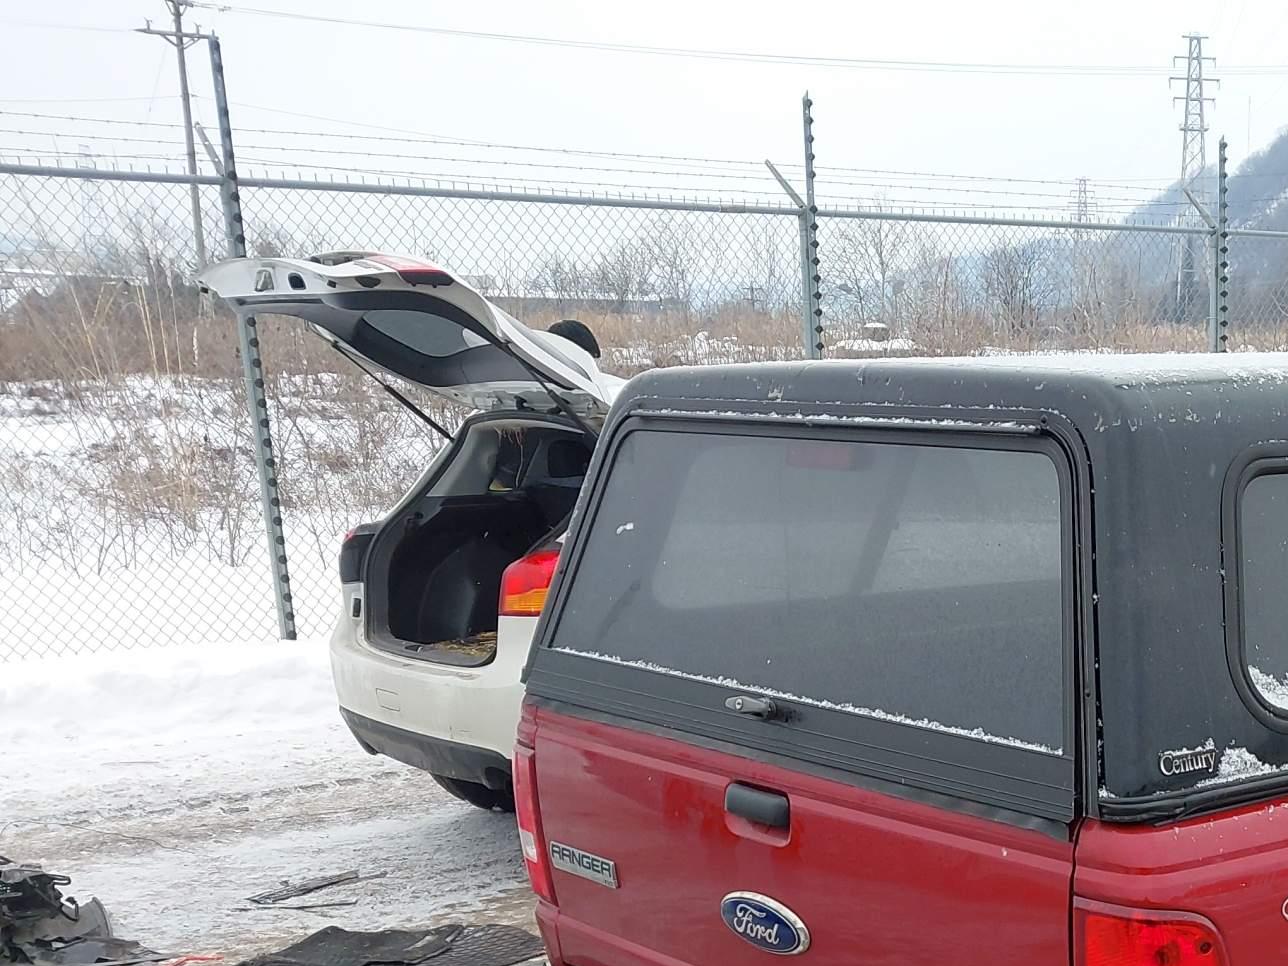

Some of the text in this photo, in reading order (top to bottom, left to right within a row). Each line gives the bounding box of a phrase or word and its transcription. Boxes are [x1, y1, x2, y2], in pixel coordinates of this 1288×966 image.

[1159, 751, 1216, 776] Century
[550, 843, 612, 878] RANGER
[733, 903, 780, 945] Ford
